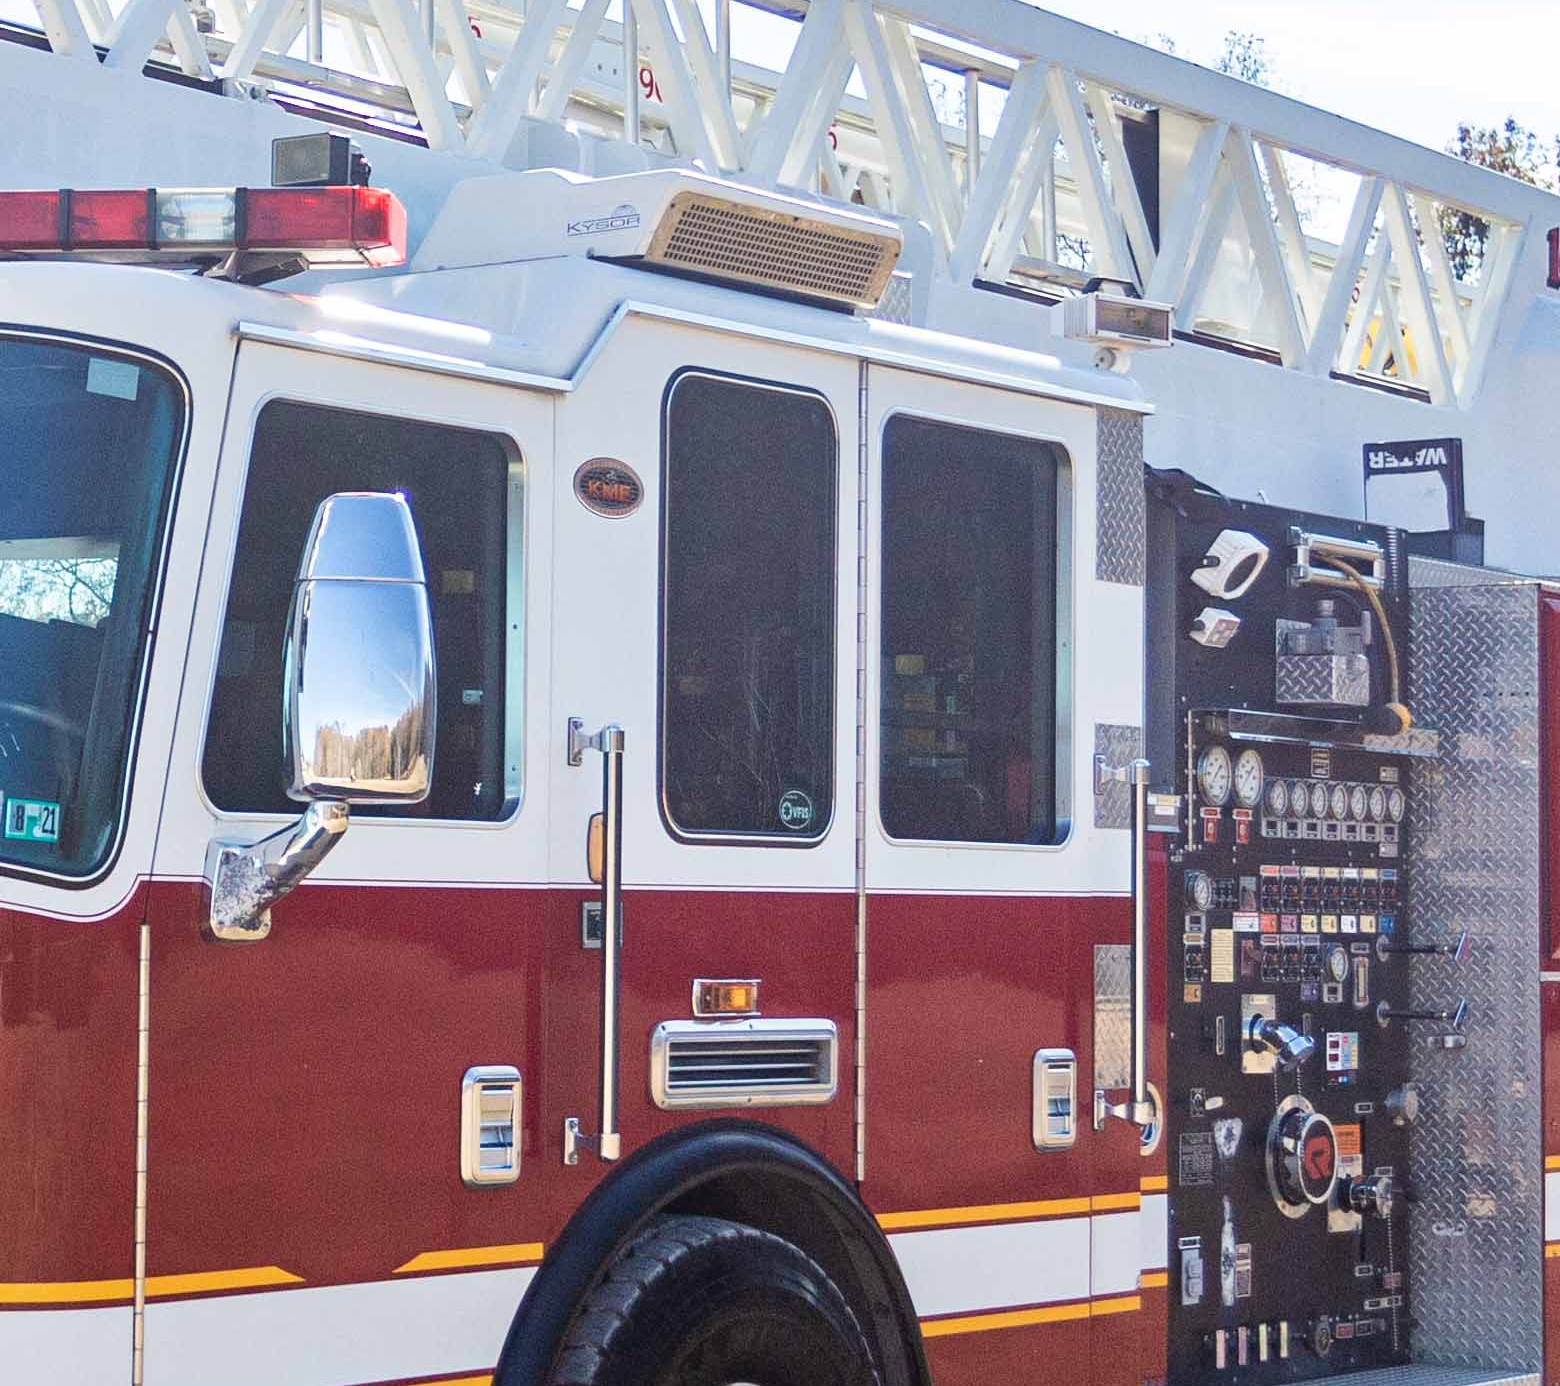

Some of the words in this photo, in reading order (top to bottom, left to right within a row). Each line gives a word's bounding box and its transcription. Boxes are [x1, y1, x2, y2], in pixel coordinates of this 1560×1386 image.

[567, 215, 641, 234] KYSOR
[1368, 447, 1448, 470] WATER
[587, 479, 632, 502] KME
[15, 804, 26, 831] 8
[41, 807, 57, 835] 21
